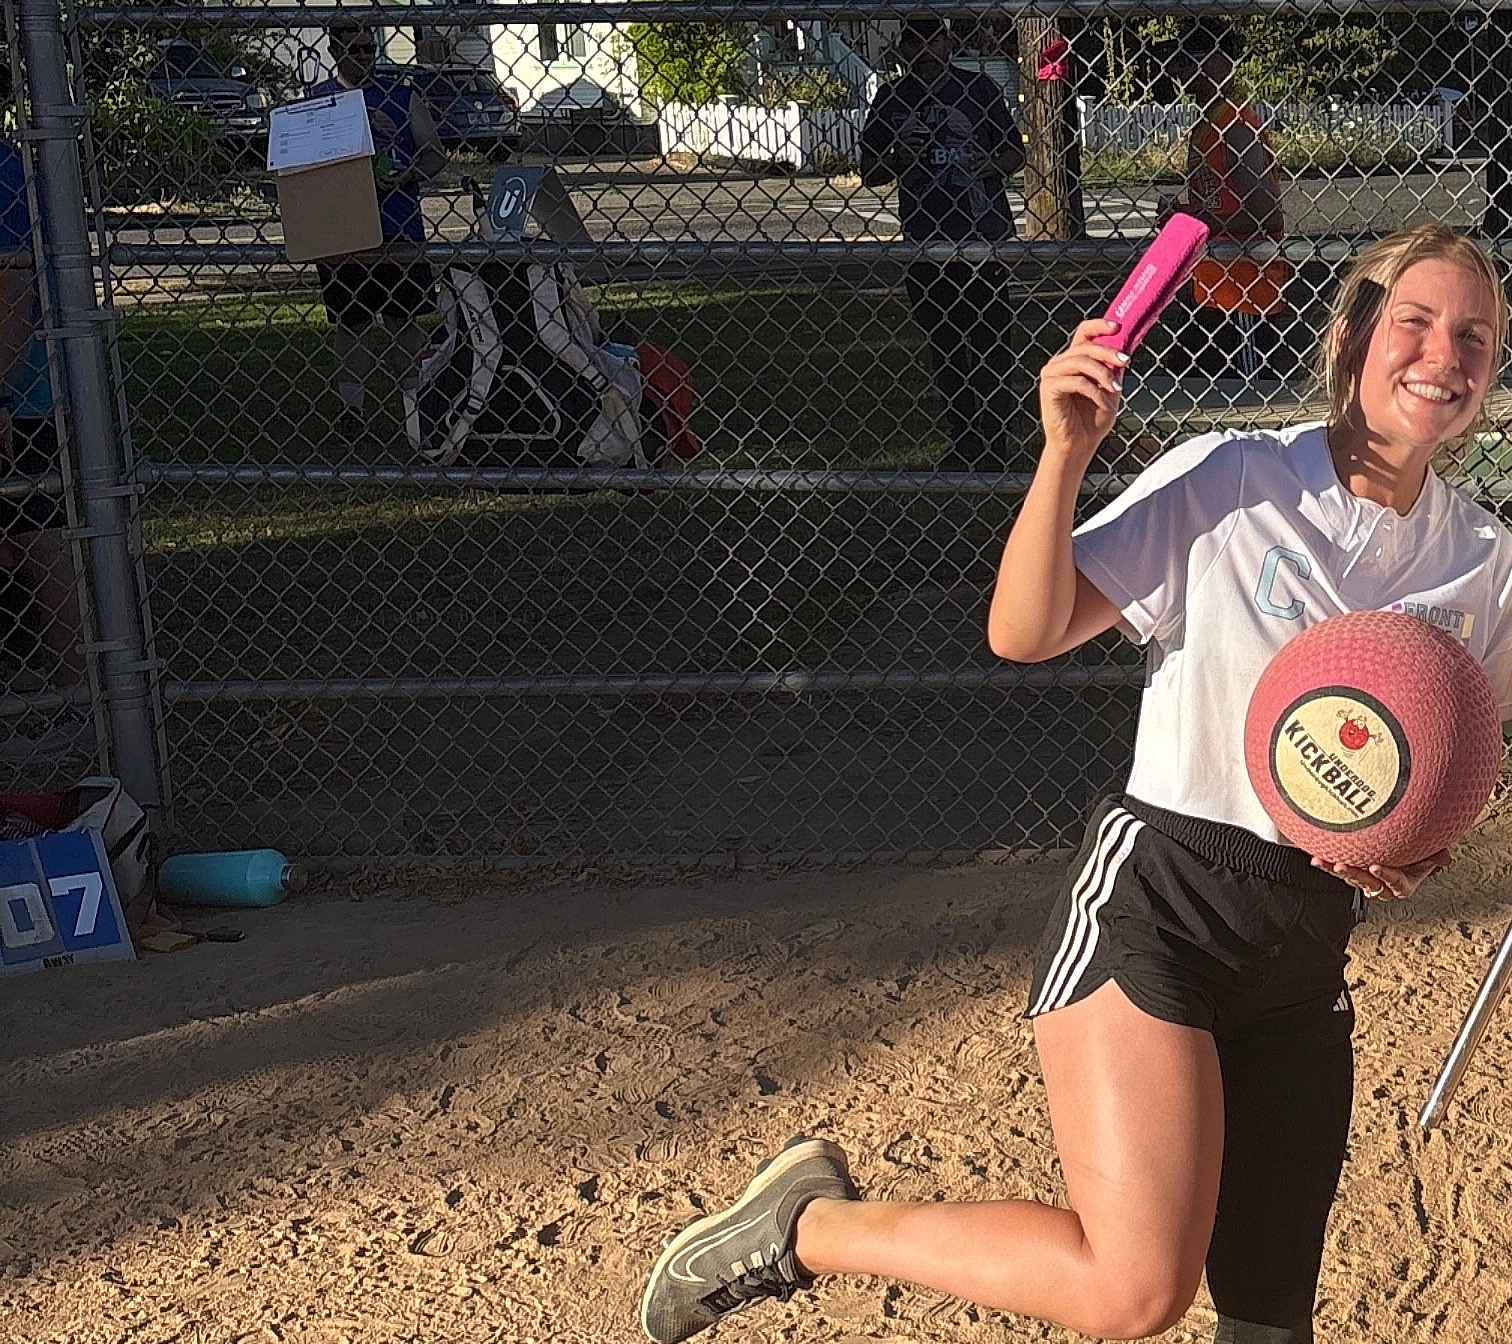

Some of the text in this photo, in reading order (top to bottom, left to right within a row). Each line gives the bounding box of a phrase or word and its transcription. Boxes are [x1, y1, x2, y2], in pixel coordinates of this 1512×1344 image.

[1255, 546, 1315, 620] C
[1404, 602, 1464, 628] FRONT
[1285, 720, 1374, 814] KICKBALL
[1328, 752, 1377, 797] UNDERDOG
